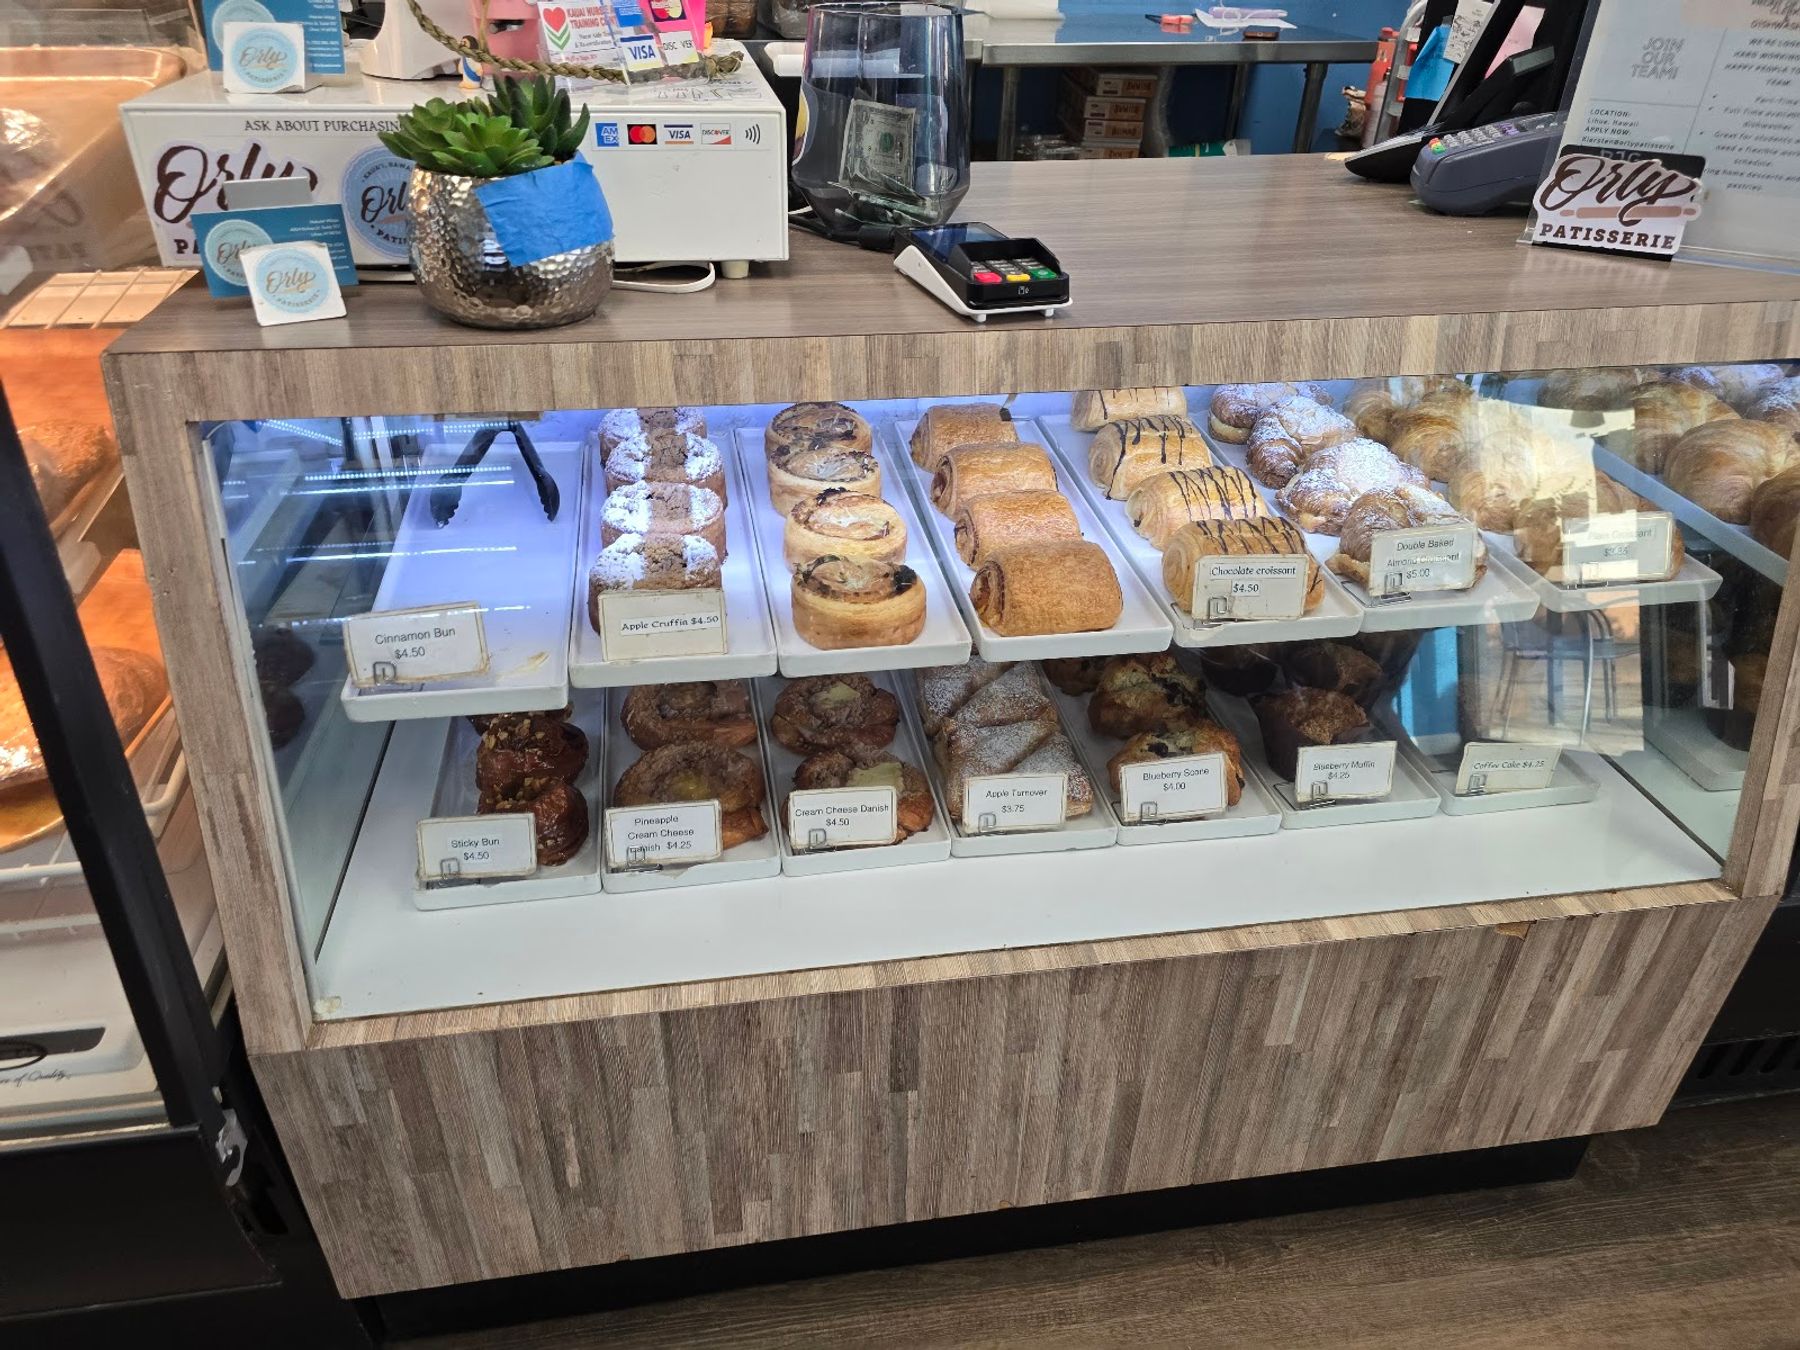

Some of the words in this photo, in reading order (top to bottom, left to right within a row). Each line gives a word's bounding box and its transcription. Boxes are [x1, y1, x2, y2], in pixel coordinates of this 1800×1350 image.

[663, 40, 693, 50] DISCVER
[1642, 38, 1685, 52] JOIN
[629, 45, 656, 60] VISA
[1641, 51, 1676, 65] OUR
[239, 47, 287, 70] Orly
[244, 120, 271, 131] ASK
[275, 120, 320, 132] ABOUT
[324, 120, 402, 132] PURCHASIN
[602, 126, 618, 135] AM
[605, 135, 618, 143] EX
[668, 130, 691, 139] VISA
[1540, 156, 1696, 227] Orly
[361, 181, 408, 223] Orl
[1540, 222, 1677, 250] PATISSERIE
[266, 267, 316, 293] Orly
[1397, 540, 1425, 551] Double
[1428, 538, 1454, 548] Baked
[1211, 566, 1254, 576] Chocolate
[1256, 566, 1296, 575] croissant
[1233, 583, 1259, 593] $4.50
[622, 621, 649, 632] Apple
[652, 618, 688, 628] Cruffin
[691, 615, 719, 625] $4.50
[374, 630, 431, 645] Cinnamon
[434, 627, 456, 638] Bun
[394, 647, 426, 660] $4.50
[1313, 762, 1348, 771] Blueberry
[1350, 760, 1375, 769] Muffin
[1473, 761, 1500, 770] Coffee
[1501, 760, 1521, 769] Cake
[1143, 771, 1182, 781] Blueberry
[1184, 768, 1210, 777] Scone
[1328, 771, 1350, 780] $4.25
[1163, 782, 1186, 791] $4.00
[985, 789, 1009, 798] Apple
[1011, 788, 1048, 797] Turnover
[795, 808, 824, 817] Cream
[825, 805, 858, 815] Cheese
[860, 804, 889, 813] Danish
[1001, 804, 1025, 813] $3.75
[635, 815, 679, 826] Pineapple
[826, 818, 850, 827] $4.50
[627, 831, 658, 841] Cream
[660, 828, 695, 838] Cheese
[451, 839, 479, 849] Sticky
[482, 838, 500, 846] Bun
[666, 841, 692, 850] $4.25
[463, 851, 489, 861] $4.50
